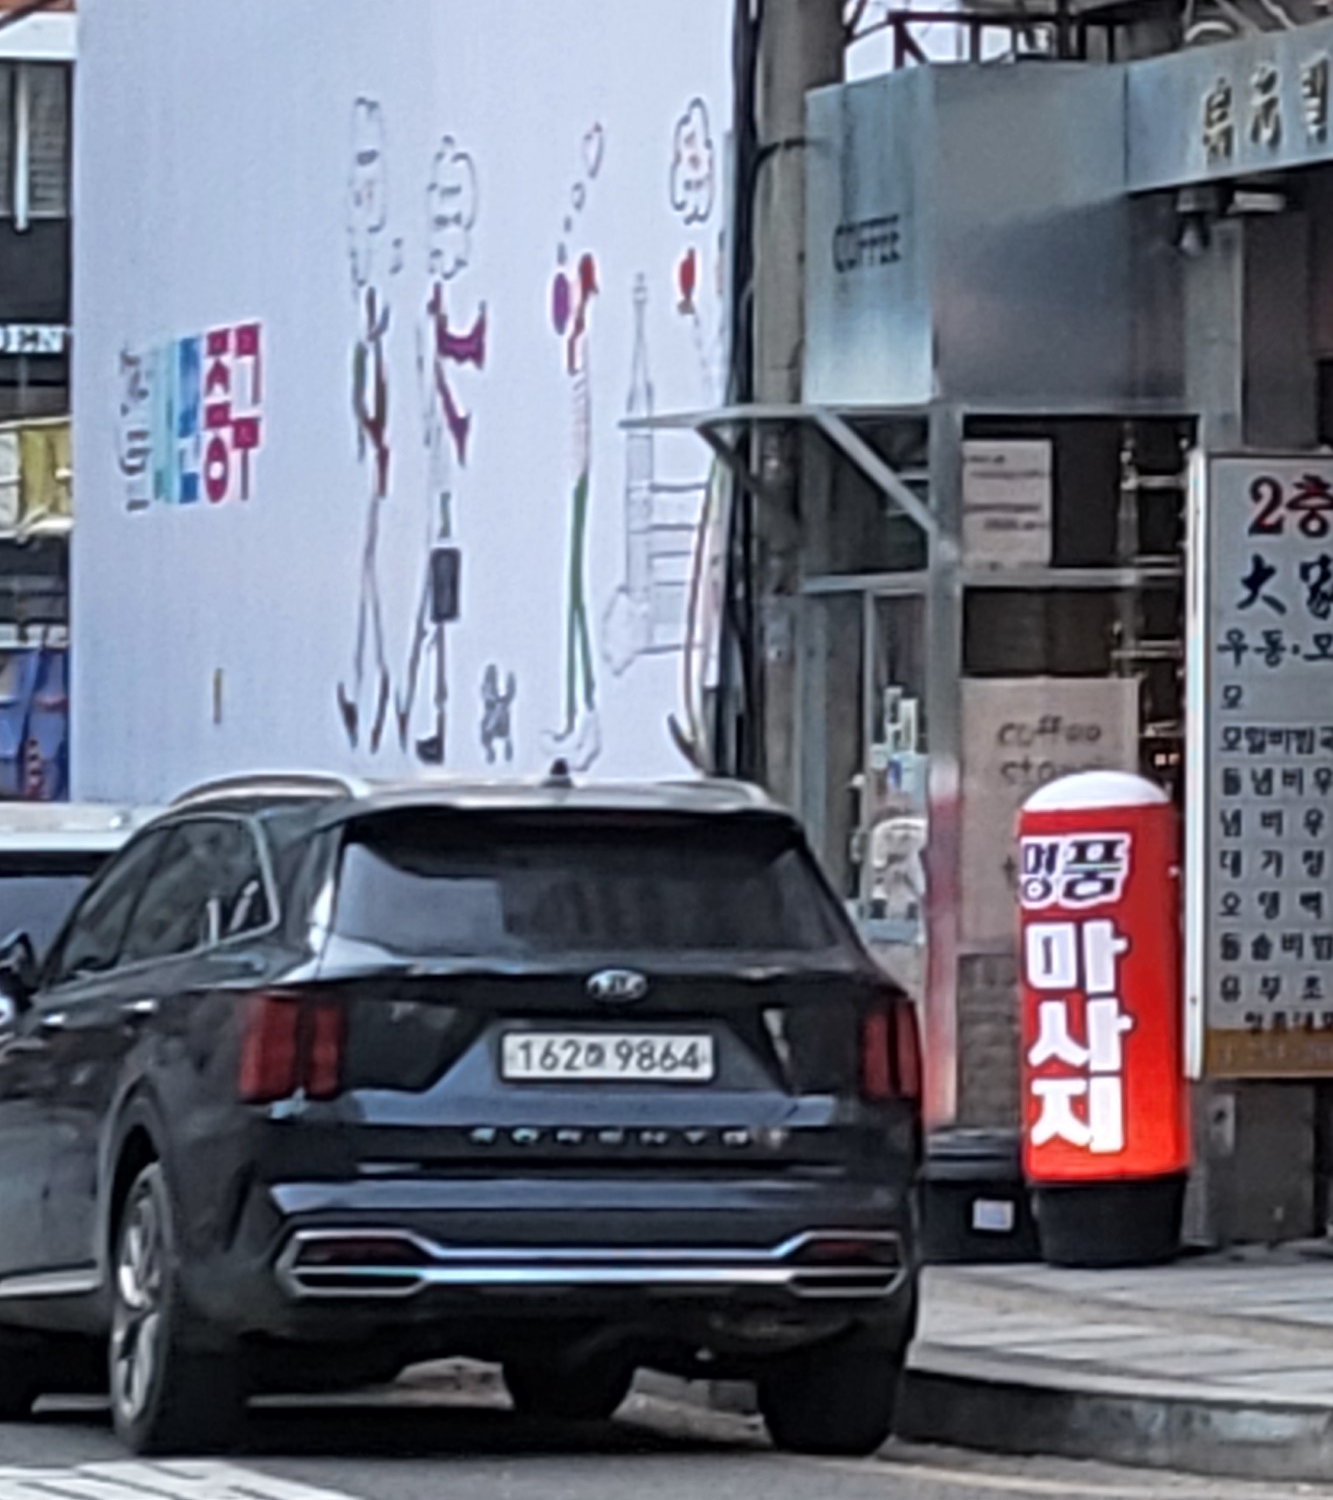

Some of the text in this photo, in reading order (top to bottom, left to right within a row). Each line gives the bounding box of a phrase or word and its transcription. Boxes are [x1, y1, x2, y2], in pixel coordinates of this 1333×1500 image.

[1018, 831, 1132, 905] 명품
[614, 1039, 700, 1072] 9864
[1025, 919, 1132, 1155] 마사지
